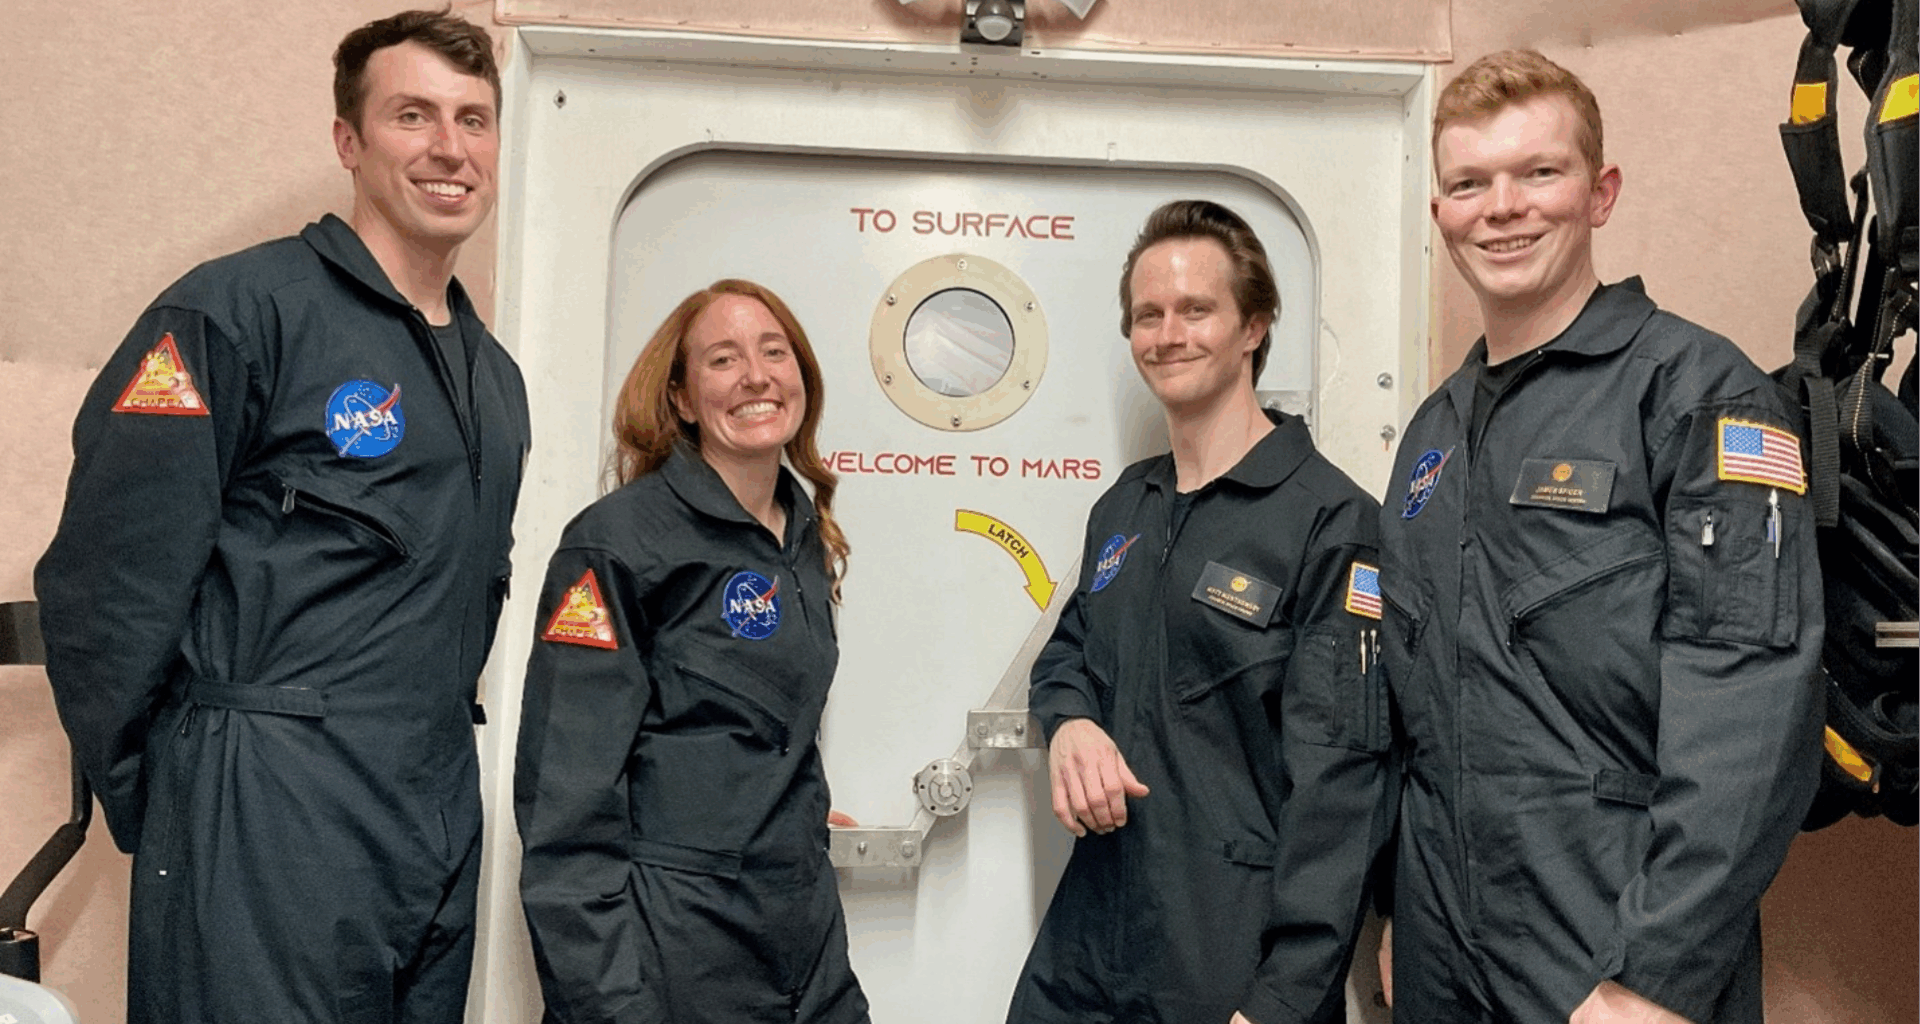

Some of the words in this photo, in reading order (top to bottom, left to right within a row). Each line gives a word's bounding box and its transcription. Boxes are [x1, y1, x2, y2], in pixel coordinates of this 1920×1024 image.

[850, 208, 896, 233] TO
[913, 211, 1075, 240] SURFACE
[333, 410, 399, 431] NASA
[971, 455, 1009, 477] TO
[1022, 458, 1101, 480] MARS
[1410, 475, 1434, 494] NASA
[988, 523, 1030, 559] LATCH
[1097, 555, 1121, 573] NASA
[729, 597, 777, 615] NASA
